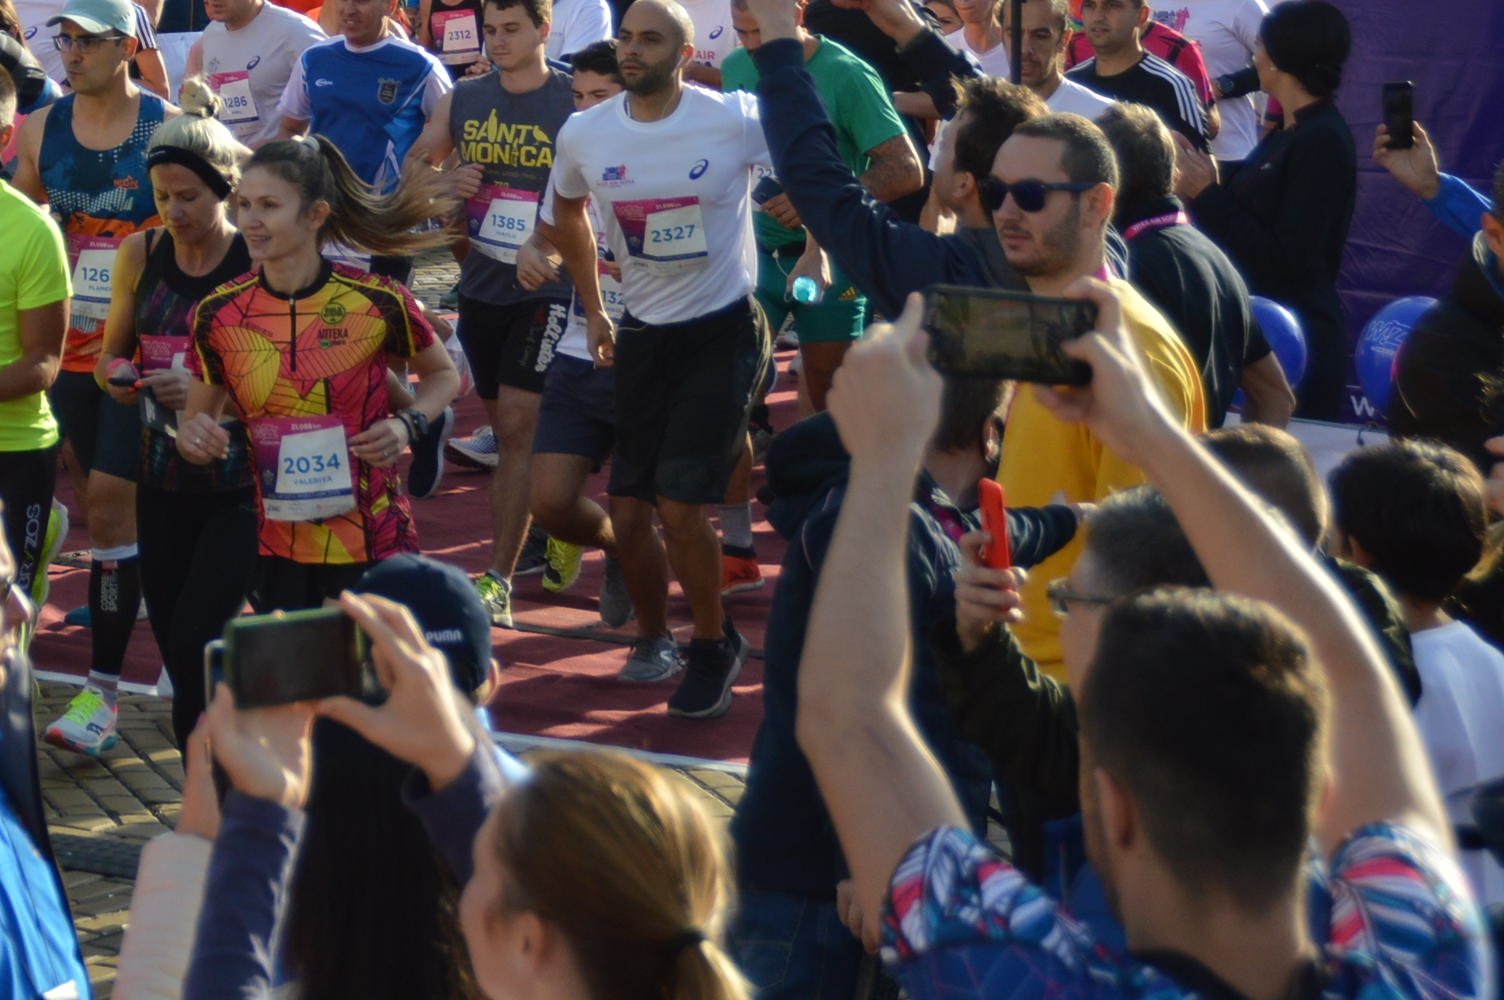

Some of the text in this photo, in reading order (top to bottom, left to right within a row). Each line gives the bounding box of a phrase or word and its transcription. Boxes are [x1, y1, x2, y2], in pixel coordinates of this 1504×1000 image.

[448, 30, 471, 41] 2312
[697, 50, 715, 60] AIR
[224, 96, 247, 108] 1286
[491, 213, 526, 231] 1385
[651, 224, 695, 243] 2327
[283, 453, 340, 474] 2034
[426, 630, 462, 641] PUMA
